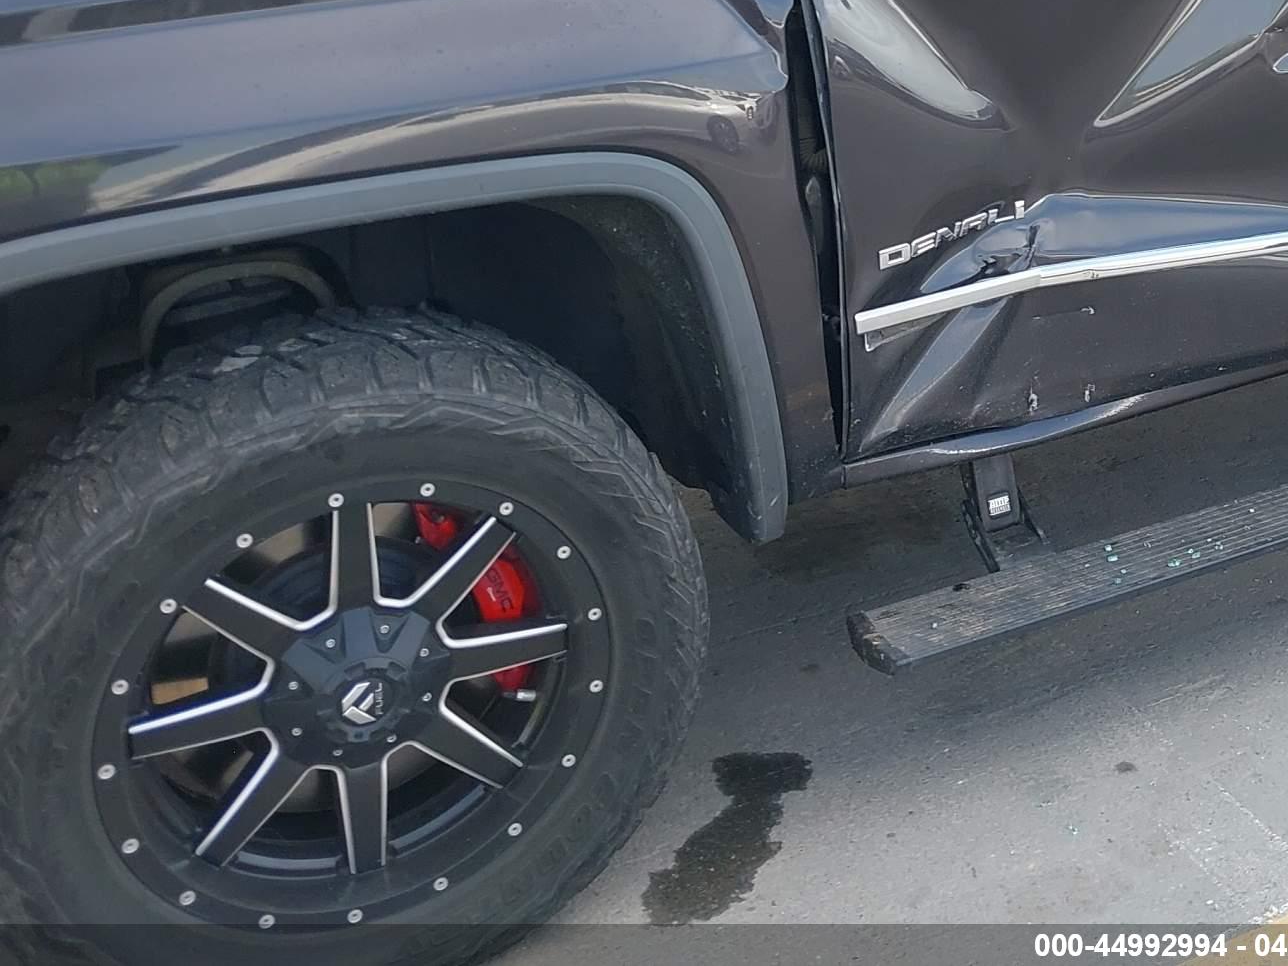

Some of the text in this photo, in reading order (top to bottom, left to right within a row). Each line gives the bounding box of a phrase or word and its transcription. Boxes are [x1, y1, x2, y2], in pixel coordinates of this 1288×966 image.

[878, 200, 1025, 270] DENALI
[486, 567, 515, 613] GMC
[374, 682, 384, 715] FUEL
